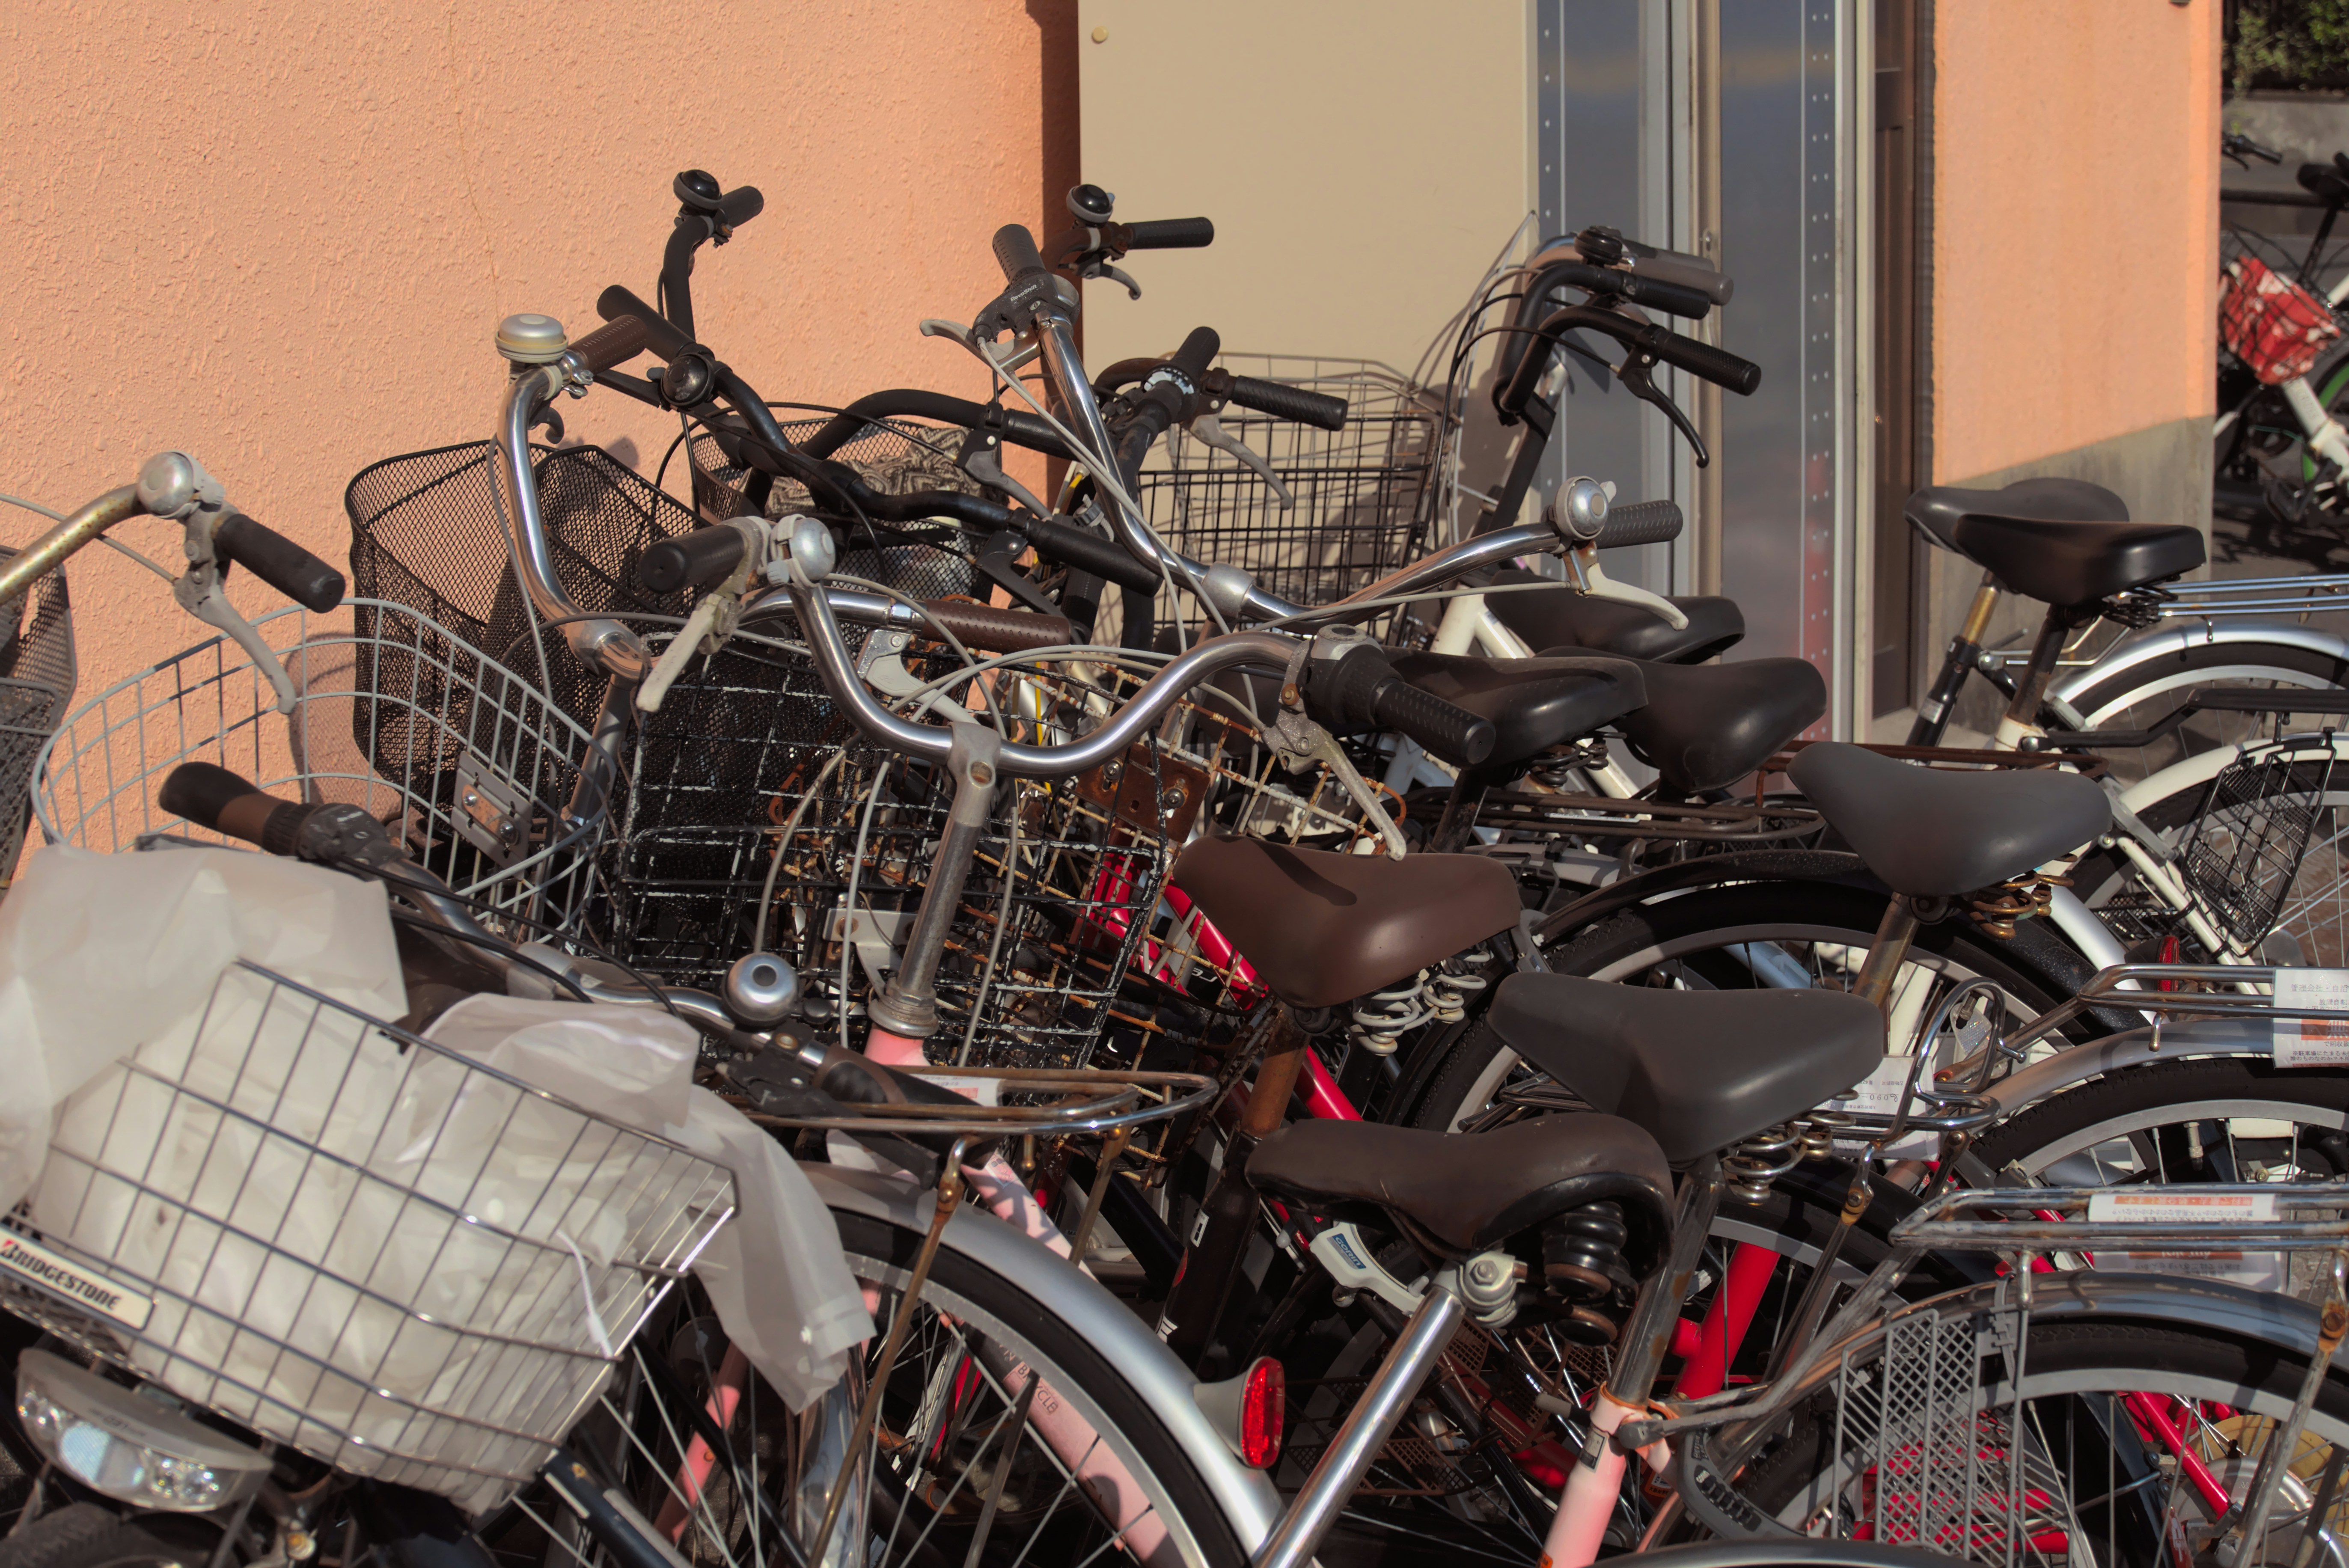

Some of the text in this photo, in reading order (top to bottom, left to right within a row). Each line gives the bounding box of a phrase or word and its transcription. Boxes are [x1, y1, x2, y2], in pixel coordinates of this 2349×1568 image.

[1, 1239, 122, 1310] BRIDGESTONE
[1335, 1236, 1362, 1266] GORIN
[1017, 1365, 1059, 1413] BICLE
